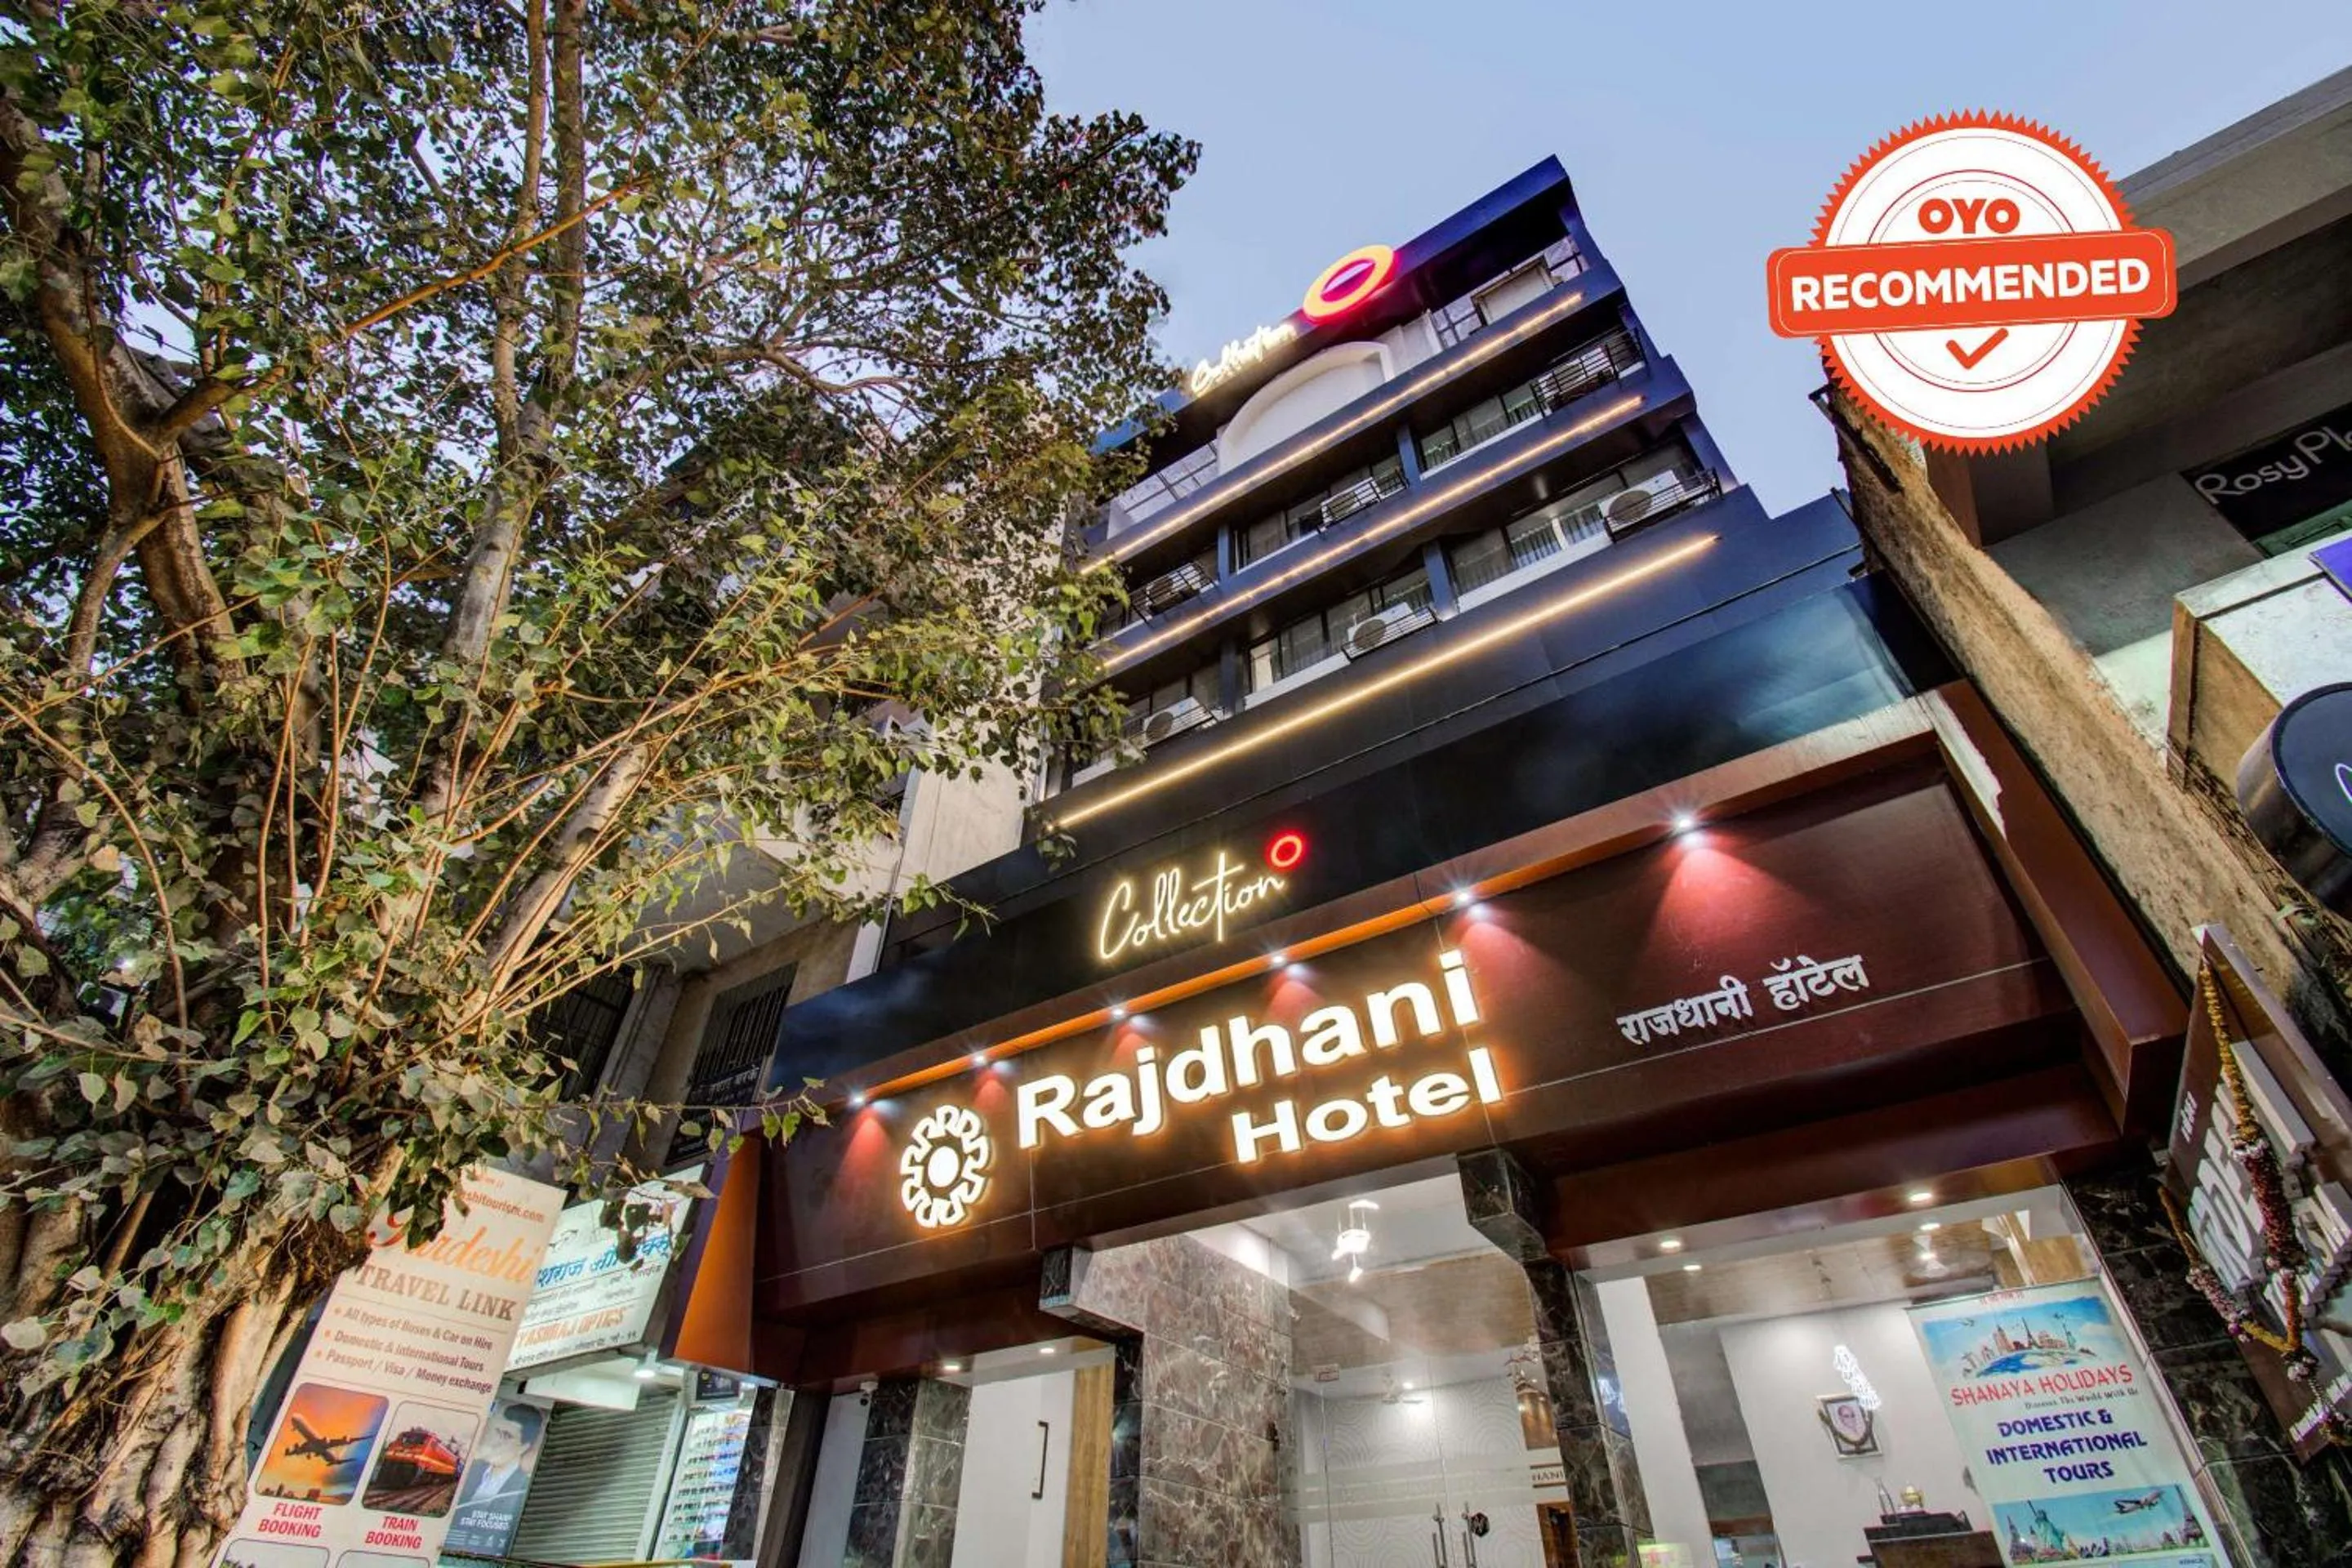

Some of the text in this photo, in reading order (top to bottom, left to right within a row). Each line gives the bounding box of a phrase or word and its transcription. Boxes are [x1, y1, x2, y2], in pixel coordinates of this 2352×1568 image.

[1099, 853, 1285, 960] Collection
[1616, 954, 1869, 1045] राजधानी हॉटेल
[1018, 949, 1479, 1149] Rajdhani
[1231, 1047, 1503, 1164] Hotel
[355, 1265, 450, 1305] TRAVEL
[456, 1289, 516, 1321] LINK
[360, 1309, 385, 1327] types
[389, 1316, 401, 1329] of
[442, 1330, 459, 1342] Car
[334, 1330, 385, 1352] Domestic
[460, 1356, 484, 1373] Tours
[326, 1348, 375, 1369] Passport
[384, 1361, 406, 1376] Visa
[415, 1367, 448, 1387] Money
[448, 1374, 493, 1394] exchange
[1951, 1365, 2132, 1405] SHANAYA HOLIDAYS
[1998, 1409, 2114, 1437] DOMESTIC &
[1985, 1431, 2147, 1465] INTERNATIONAL
[2044, 1461, 2114, 1484] TOURS
[258, 1518, 322, 1539] BOOKING
[274, 1503, 323, 1520] FLIGHT
[382, 1516, 419, 1531] TRAIN
[365, 1531, 422, 1549] BOOKING
